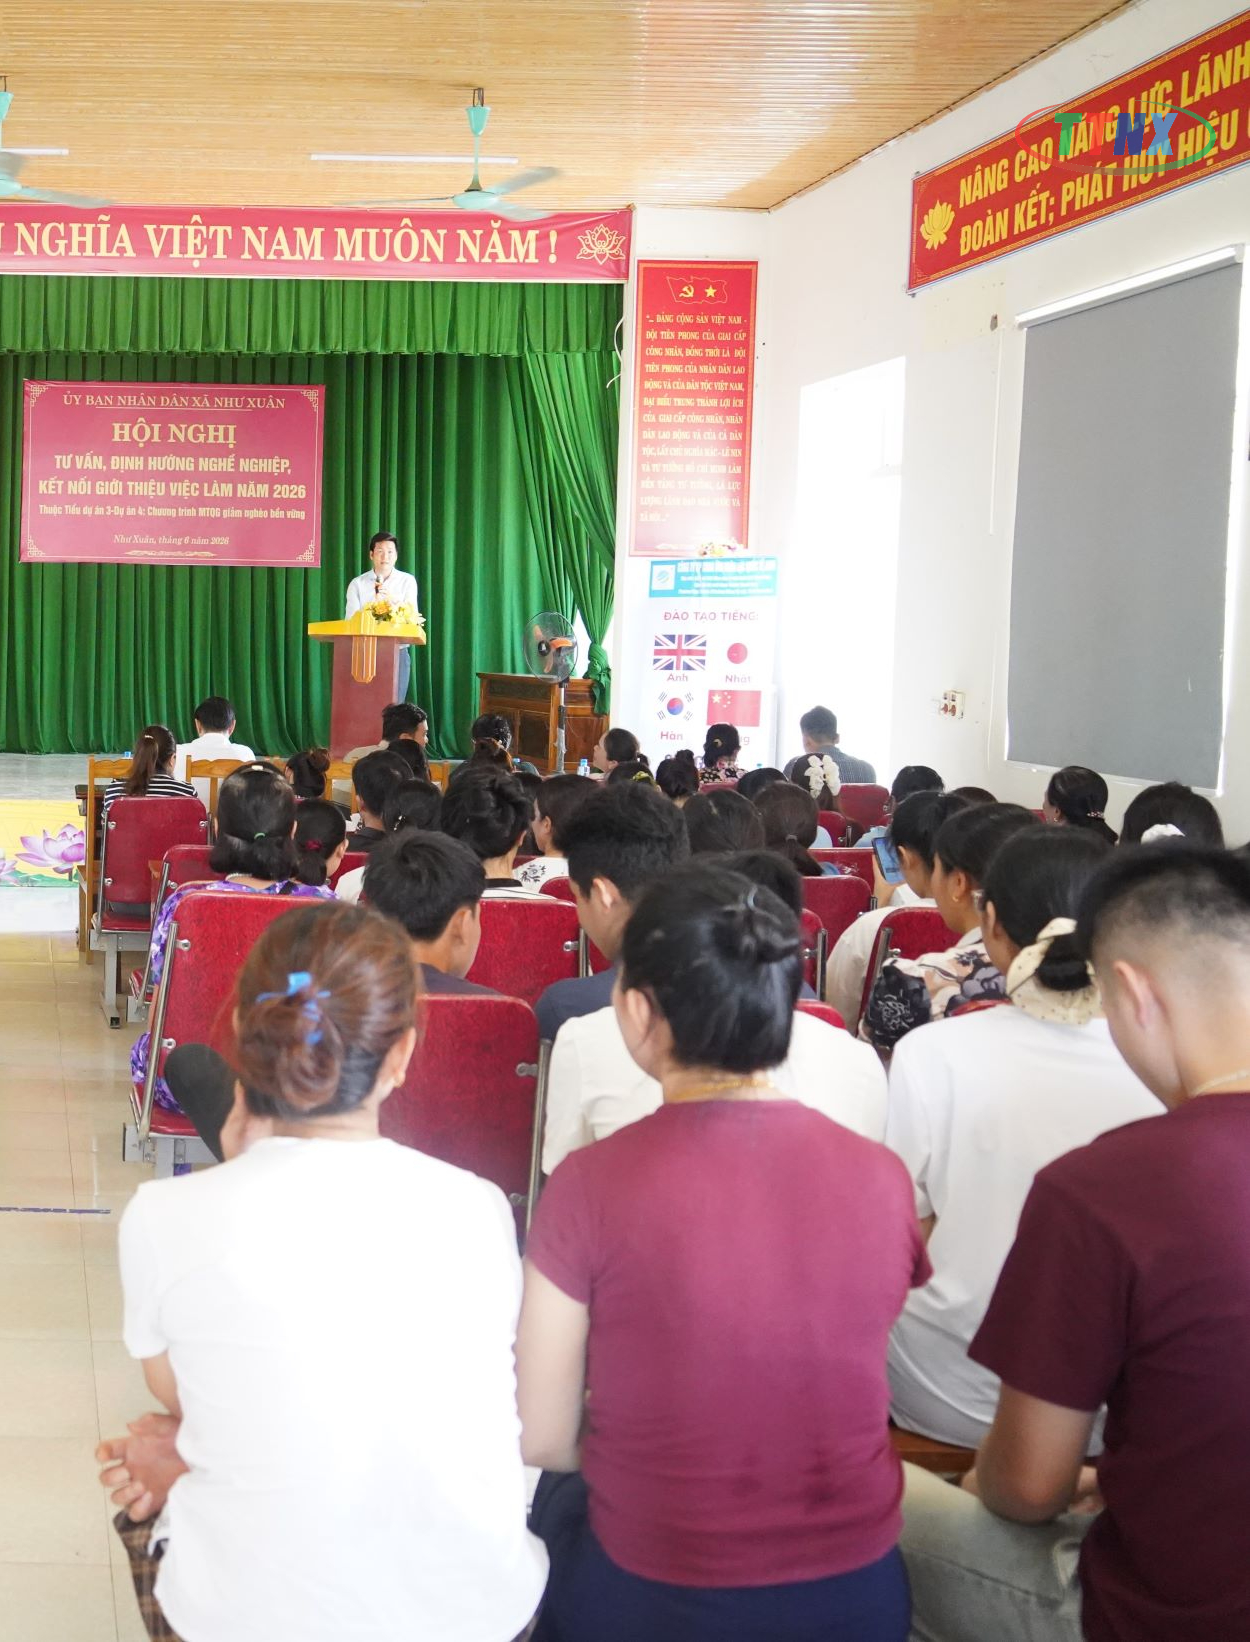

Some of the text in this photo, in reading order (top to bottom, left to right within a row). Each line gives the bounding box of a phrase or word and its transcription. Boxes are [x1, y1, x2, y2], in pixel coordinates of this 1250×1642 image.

[959, 158, 1009, 208] NÂNG
[1014, 137, 1053, 183] CAO
[1180, 40, 1250, 108] LÃNH
[959, 207, 1009, 256] ĐOÀN
[1014, 182, 1055, 235] KẾT;
[1061, 161, 1117, 216] PHÁT
[1123, 138, 1172, 192] HUY
[1178, 109, 1239, 170] HIỆU
[15, 214, 135, 258] NGHĨA
[144, 215, 232, 268] VIỆT
[241, 226, 325, 262] NAM
[334, 217, 446, 263] MUÔN
[456, 219, 541, 264] NĂM
[729, 315, 742, 325] NAM
[678, 331, 699, 341] PHONG
[718, 332, 731, 341] GIAI
[733, 365, 745, 374] LAO
[63, 391, 285, 409] ỦY BAN NHÂN DÂN XÃ NHƯ XUÂN
[112, 417, 237, 449] HỘI NGHỊ
[54, 454, 73, 470] TƯ
[75, 451, 107, 472] VẤN,
[111, 455, 144, 473] ĐỊNH
[148, 454, 195, 472] HƯỚNG
[239, 456, 291, 475] NGHIỆP,
[39, 476, 306, 499] KẾT NỐI GIỚI THIỆU VIỆC LÀM NĂM 2026
[39, 504, 63, 516] Thuộc
[198, 507, 221, 518] MTQG
[114, 534, 131, 544] Như
[159, 535, 182, 545] tháng
[211, 536, 230, 545] 2026
[664, 609, 689, 621] ĐÀO
[660, 731, 683, 741] Hàn
